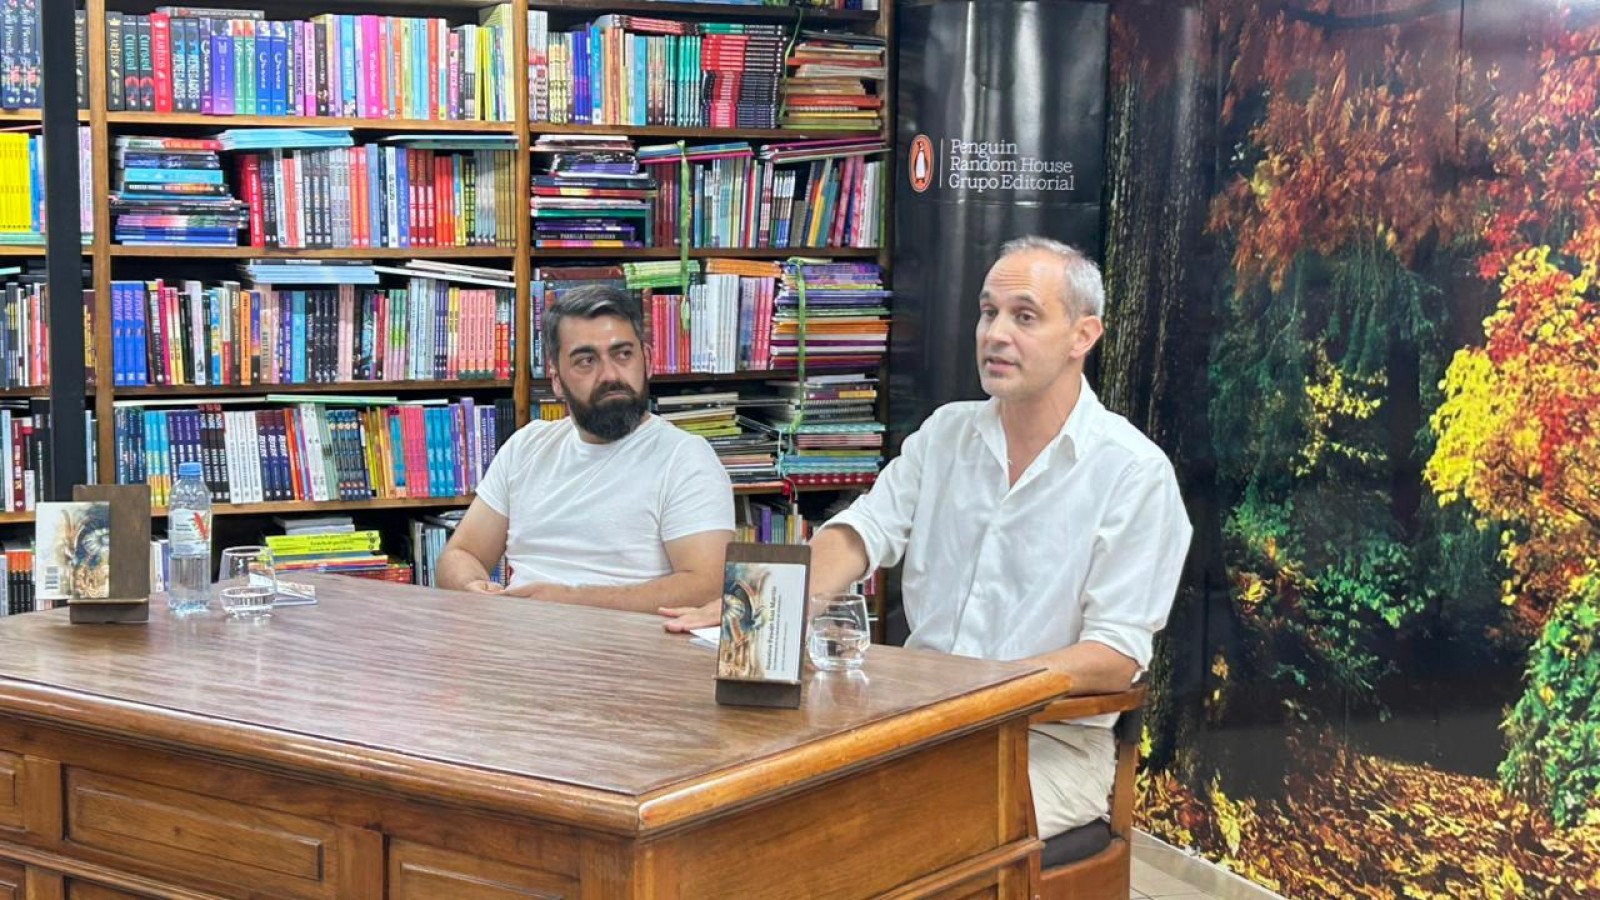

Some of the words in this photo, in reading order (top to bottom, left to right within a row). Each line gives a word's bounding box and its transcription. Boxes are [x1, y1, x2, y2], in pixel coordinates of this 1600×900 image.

[950, 138, 1018, 157] Penguin
[950, 157, 1017, 171] Random
[1020, 158, 1073, 173] House
[949, 174, 999, 193] Grupo
[1000, 174, 1075, 191] Editorial
